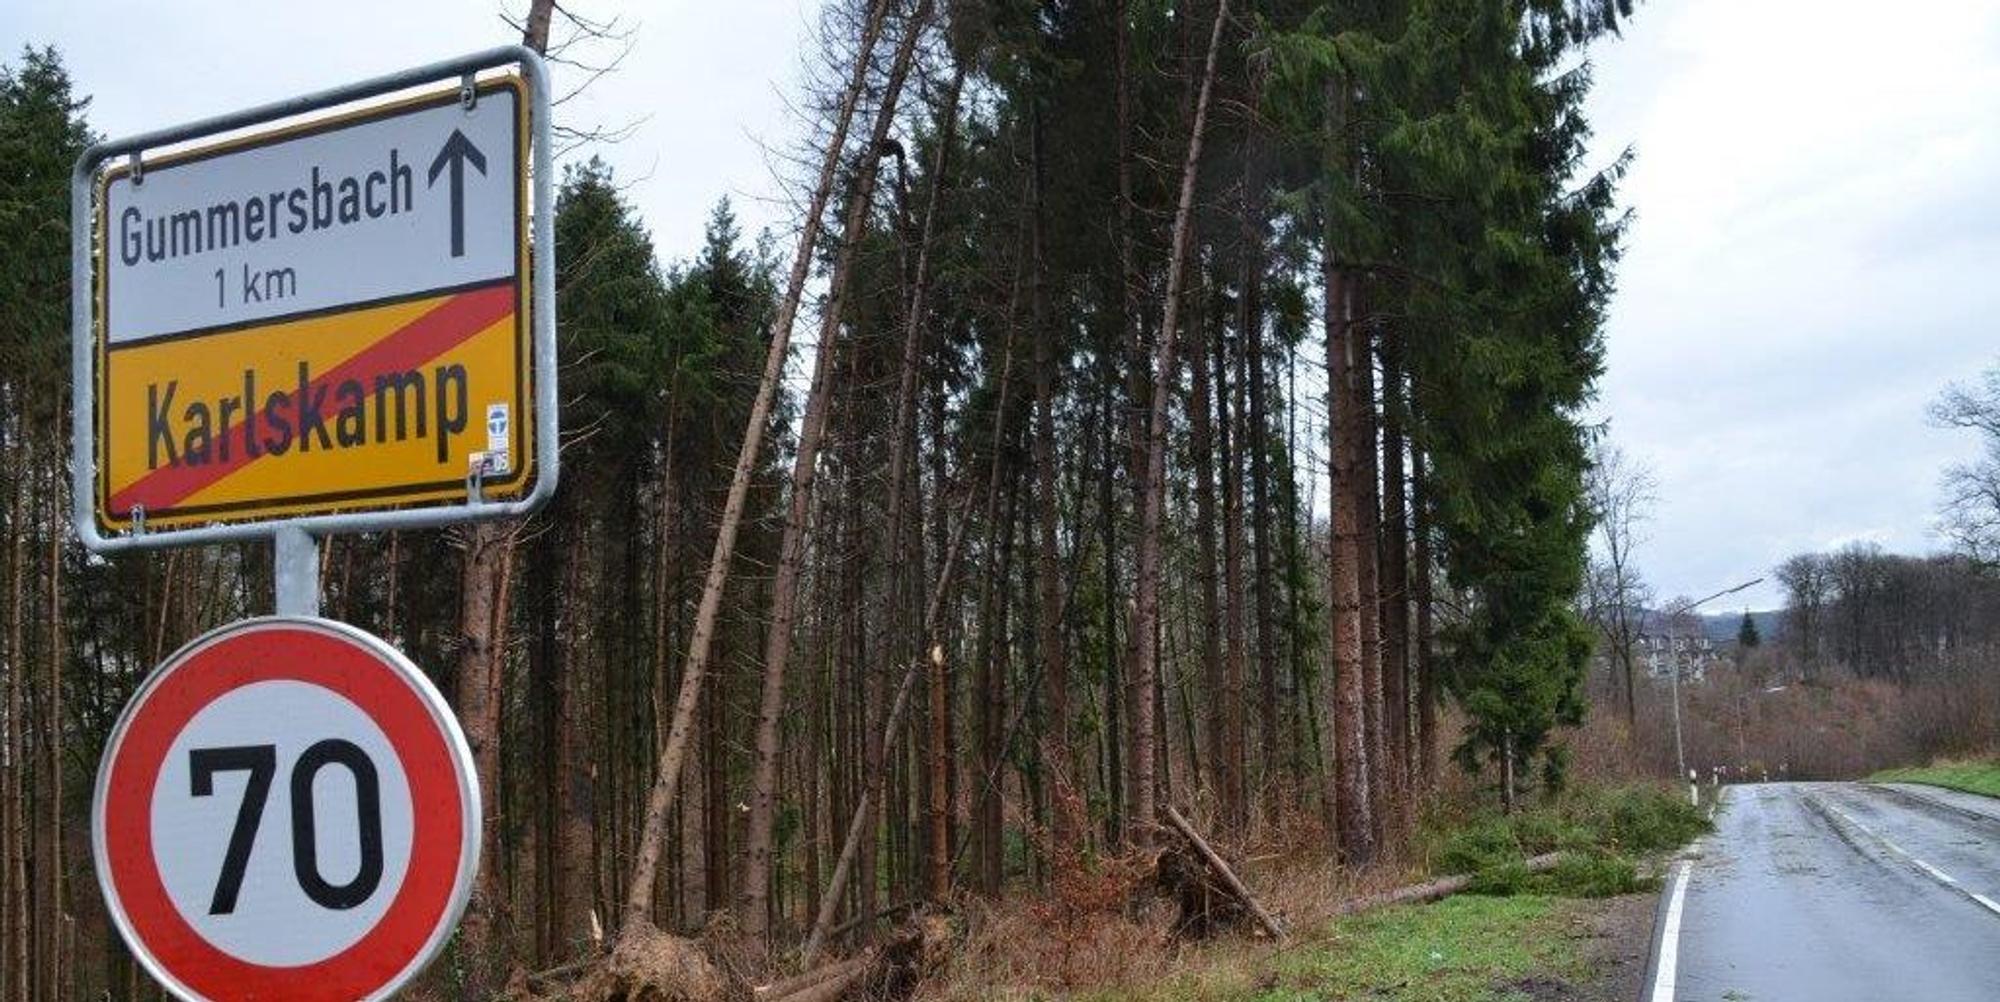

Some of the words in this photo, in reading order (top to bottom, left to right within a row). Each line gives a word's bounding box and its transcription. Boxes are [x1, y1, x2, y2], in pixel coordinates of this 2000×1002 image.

[120, 149, 413, 267] Gummersbach
[215, 268, 226, 308] 1
[243, 264, 297, 304] km
[147, 361, 469, 470] Karlskamp
[189, 738, 384, 915] 70
